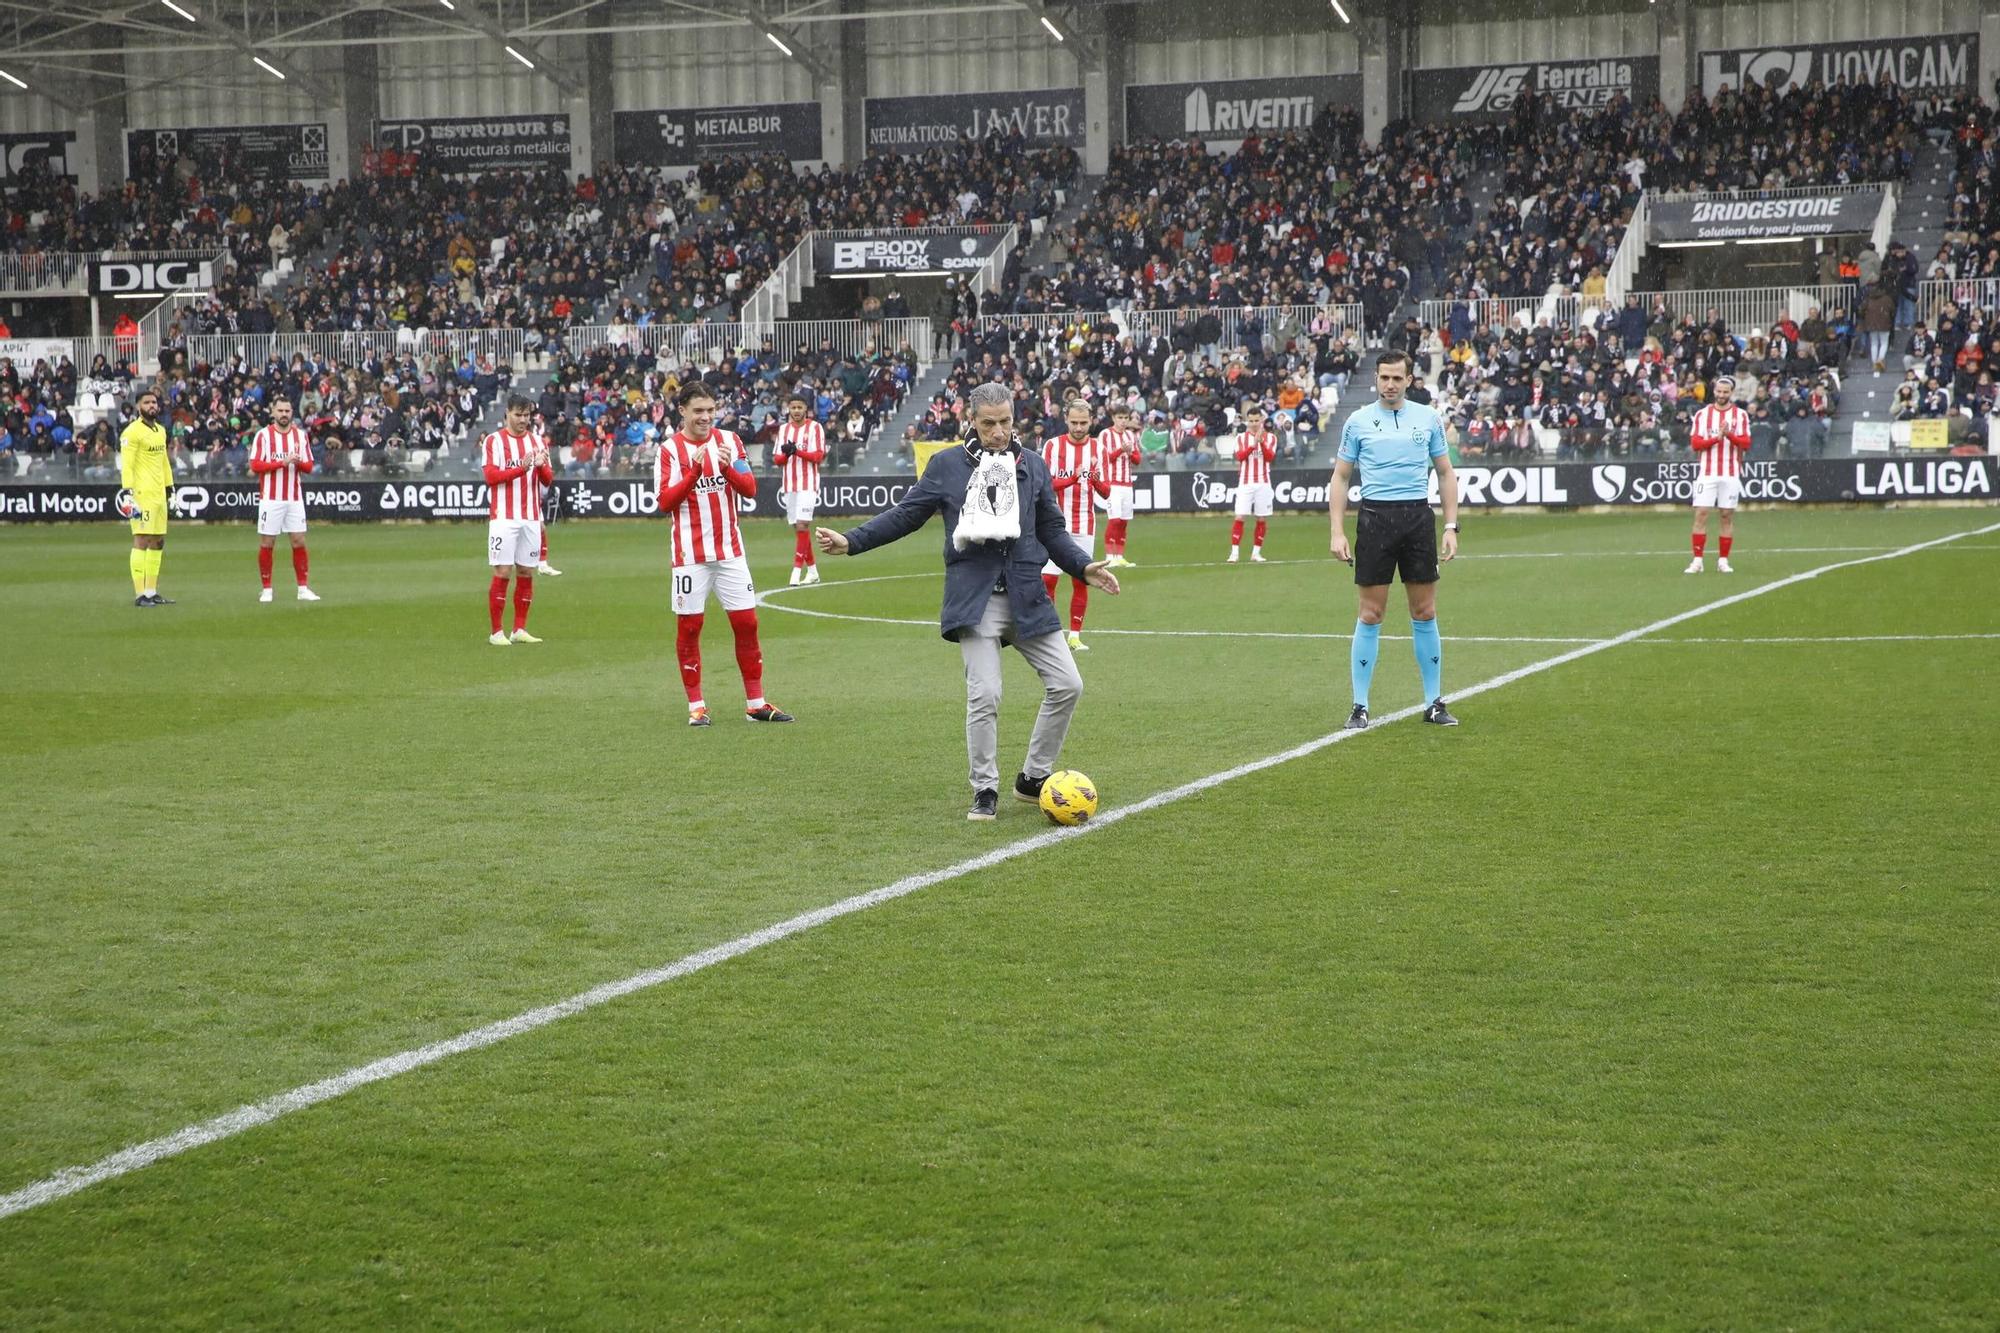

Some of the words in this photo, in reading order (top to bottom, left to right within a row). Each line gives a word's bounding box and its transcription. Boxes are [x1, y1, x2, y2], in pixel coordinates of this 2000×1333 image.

[1537, 61, 1632, 90] Ferralla
[430, 121, 546, 139] ESTRUBUR
[694, 115, 782, 137] METALBUR
[869, 123, 958, 145] NEUMÁTICOS
[435, 143, 510, 158] Estructuras
[1691, 197, 1843, 222] BRIDGESTONE
[1697, 225, 1747, 238] Solutions
[1747, 224, 1764, 236] for
[1764, 224, 1790, 237] your
[1790, 223, 1833, 236] journey
[873, 239, 930, 256] BODY
[868, 254, 930, 268] TRUCK
[942, 257, 994, 269] SCANIA
[99, 261, 213, 291] DIGI
[1855, 460, 1991, 496] LALIGA
[41, 491, 107, 513] Motor
[305, 490, 362, 506] PARDO
[675, 574, 693, 594] 10
